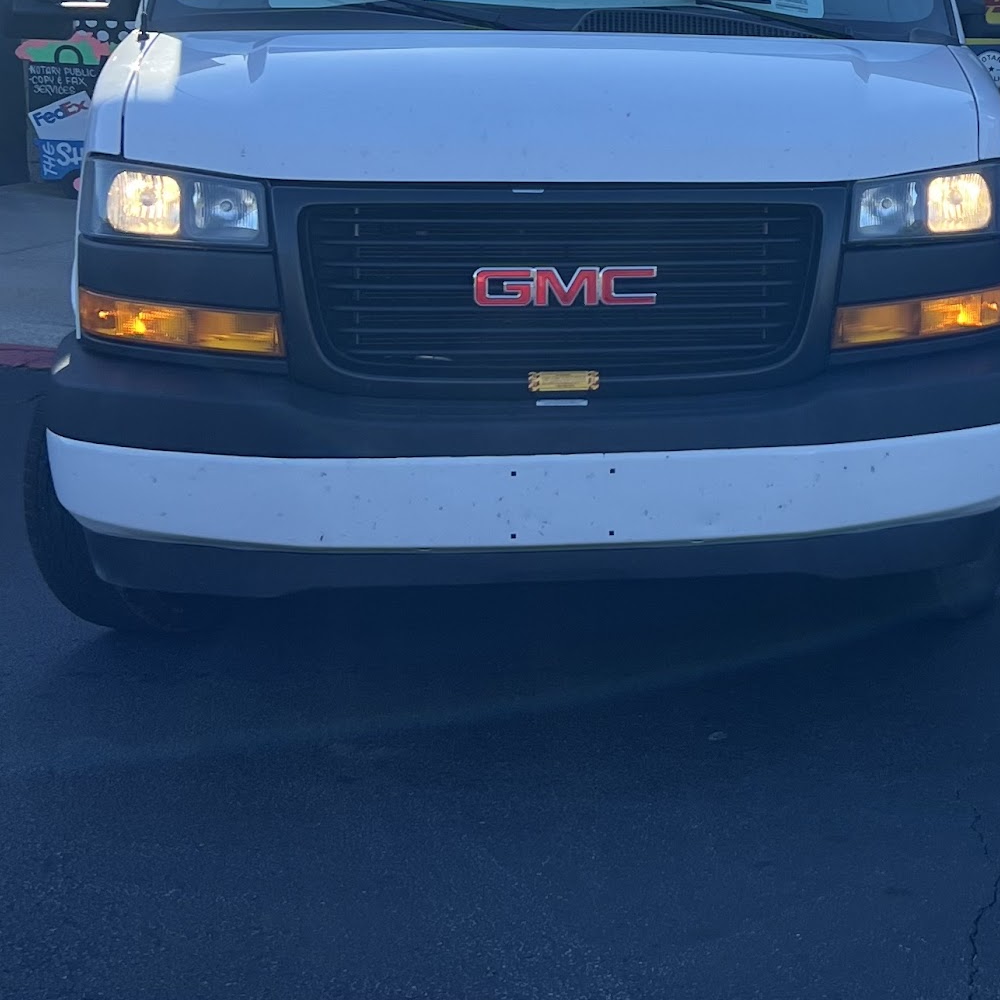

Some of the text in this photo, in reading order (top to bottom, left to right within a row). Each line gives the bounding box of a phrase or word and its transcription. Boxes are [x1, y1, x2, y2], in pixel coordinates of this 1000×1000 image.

[64, 67, 97, 77] PUBLIC
[33, 84, 76, 96] SERVICES
[65, 76, 88, 88] FAX
[33, 101, 89, 127] FedEx
[42, 141, 58, 177] THE
[473, 266, 658, 307] GMC
